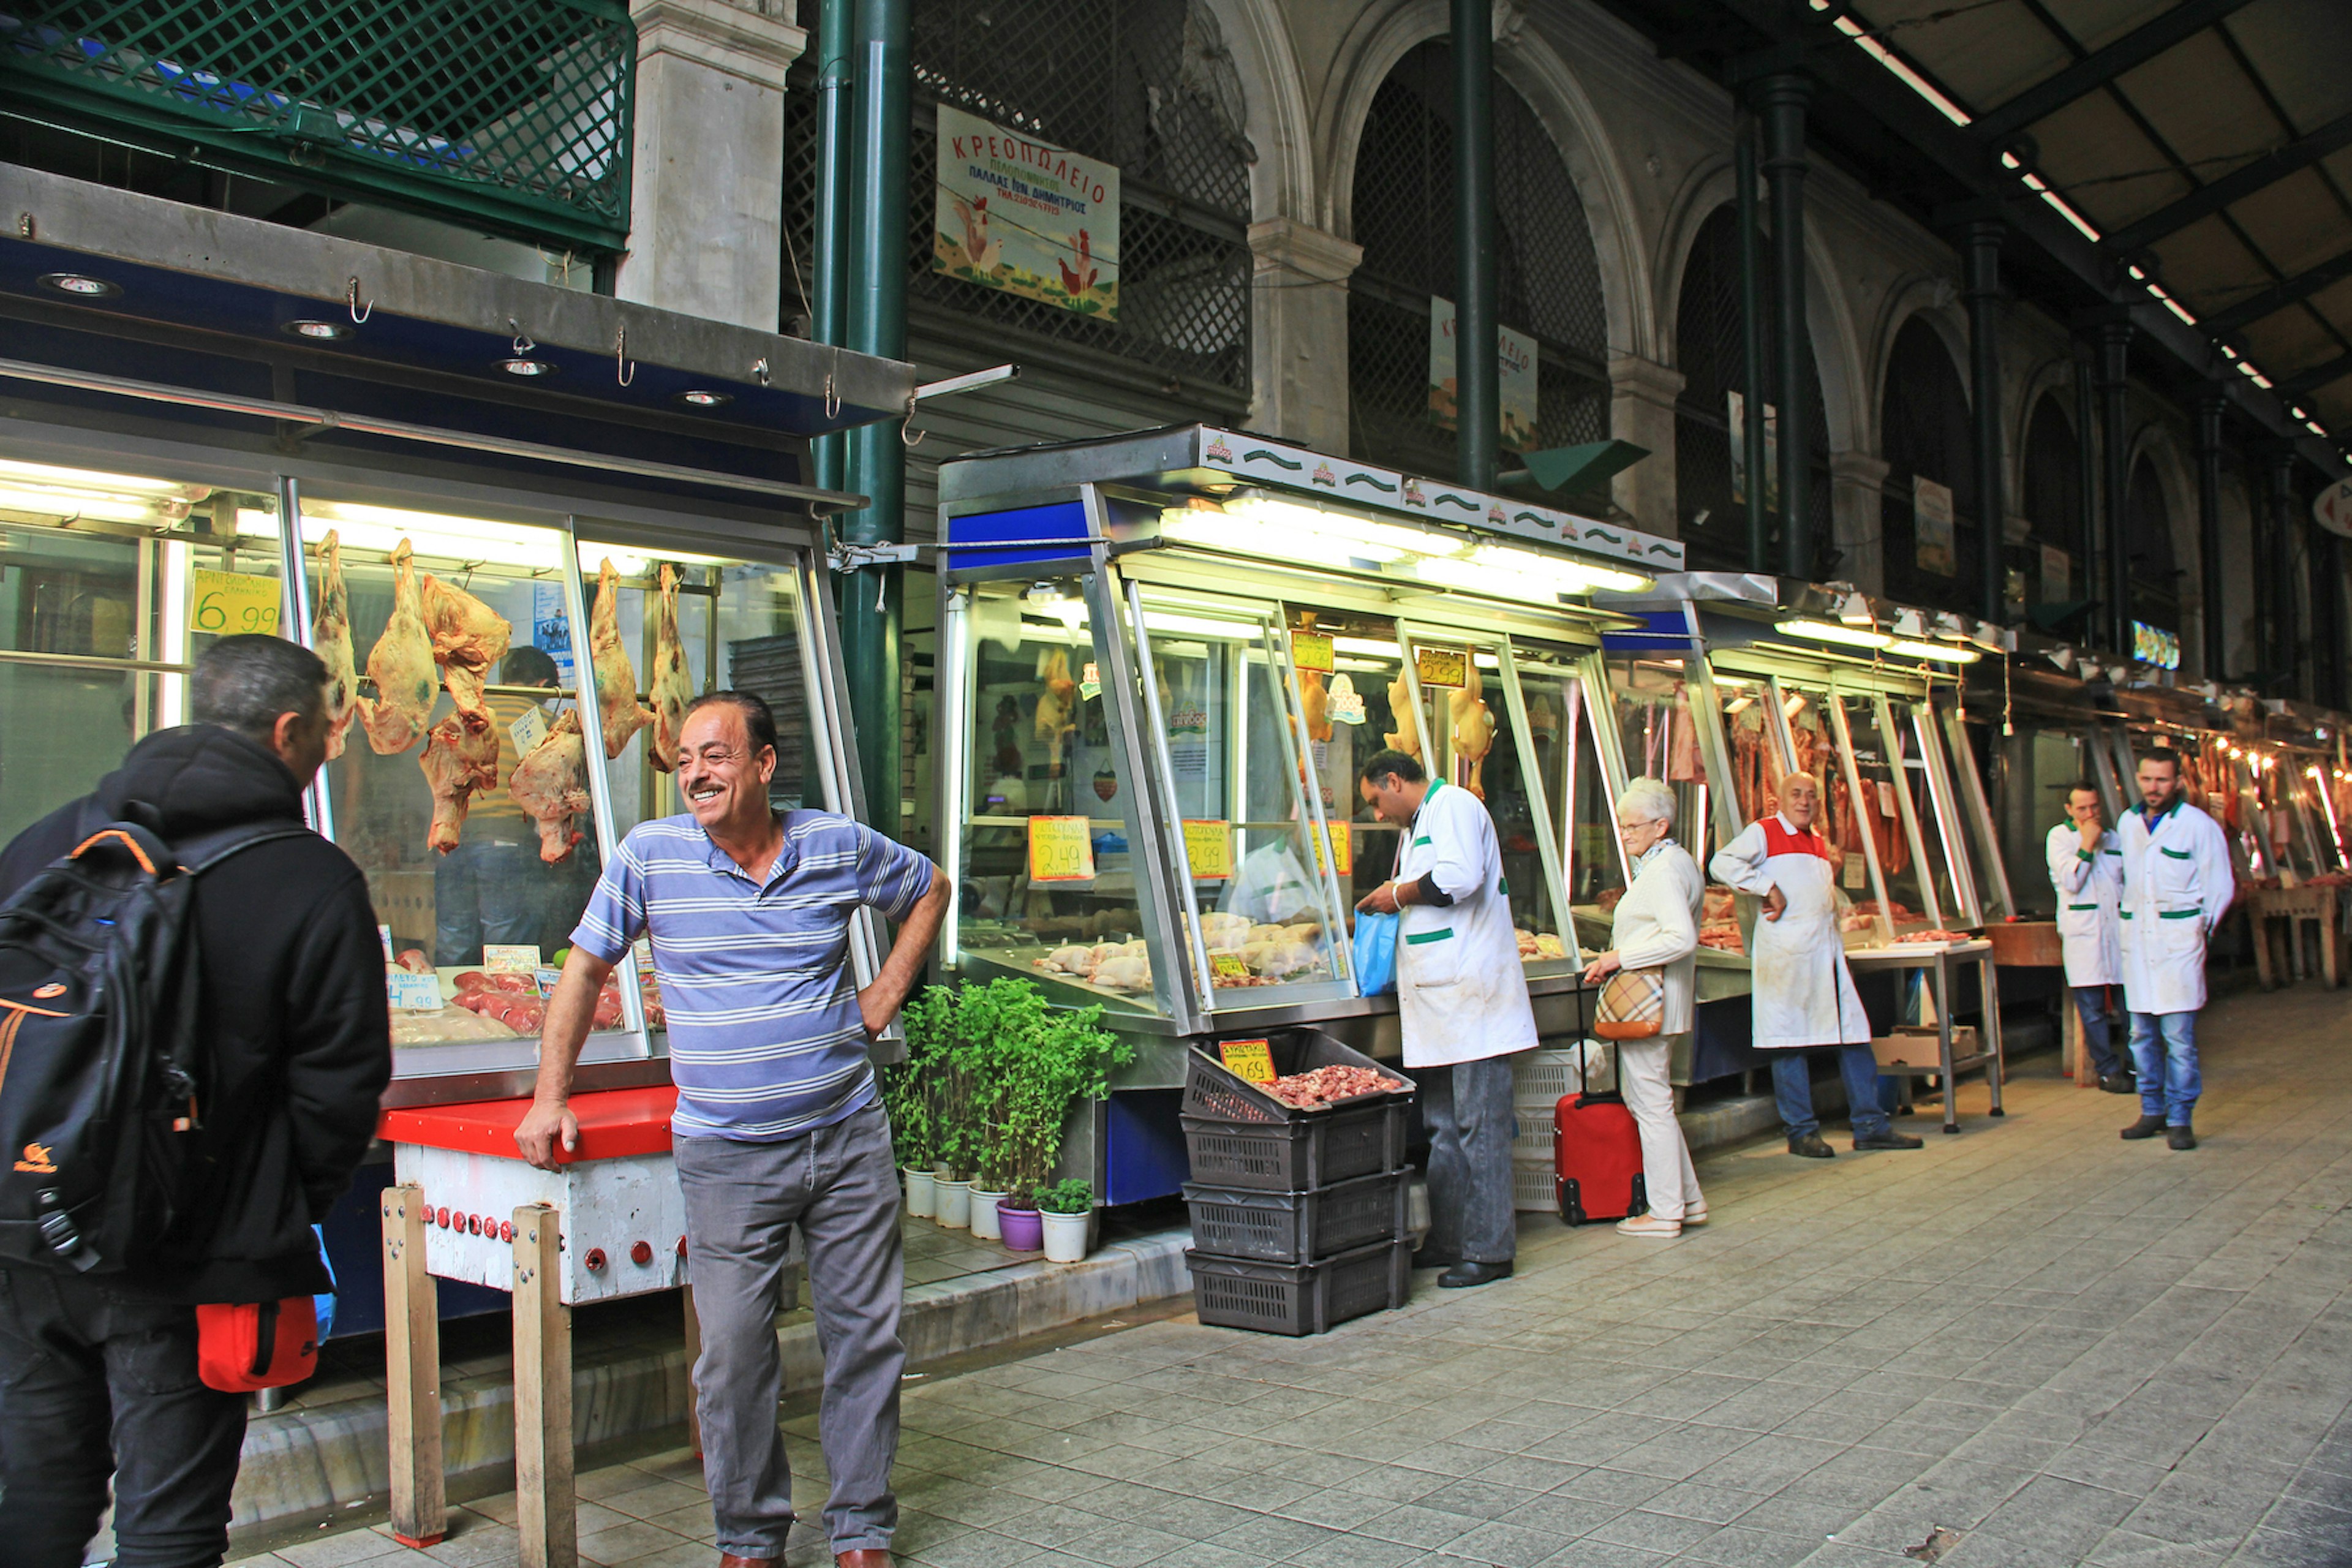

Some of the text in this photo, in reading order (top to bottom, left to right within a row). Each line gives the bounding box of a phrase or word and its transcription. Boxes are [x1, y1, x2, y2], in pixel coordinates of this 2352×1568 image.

[952, 135, 1105, 203] ΚΡΕΟΠΩΛΕΙΟ
[969, 165, 1008, 189] ΠΑΛΛΑΣ
[1032, 188, 1087, 214] ΔΗΜΗΤΡΙΟΣ
